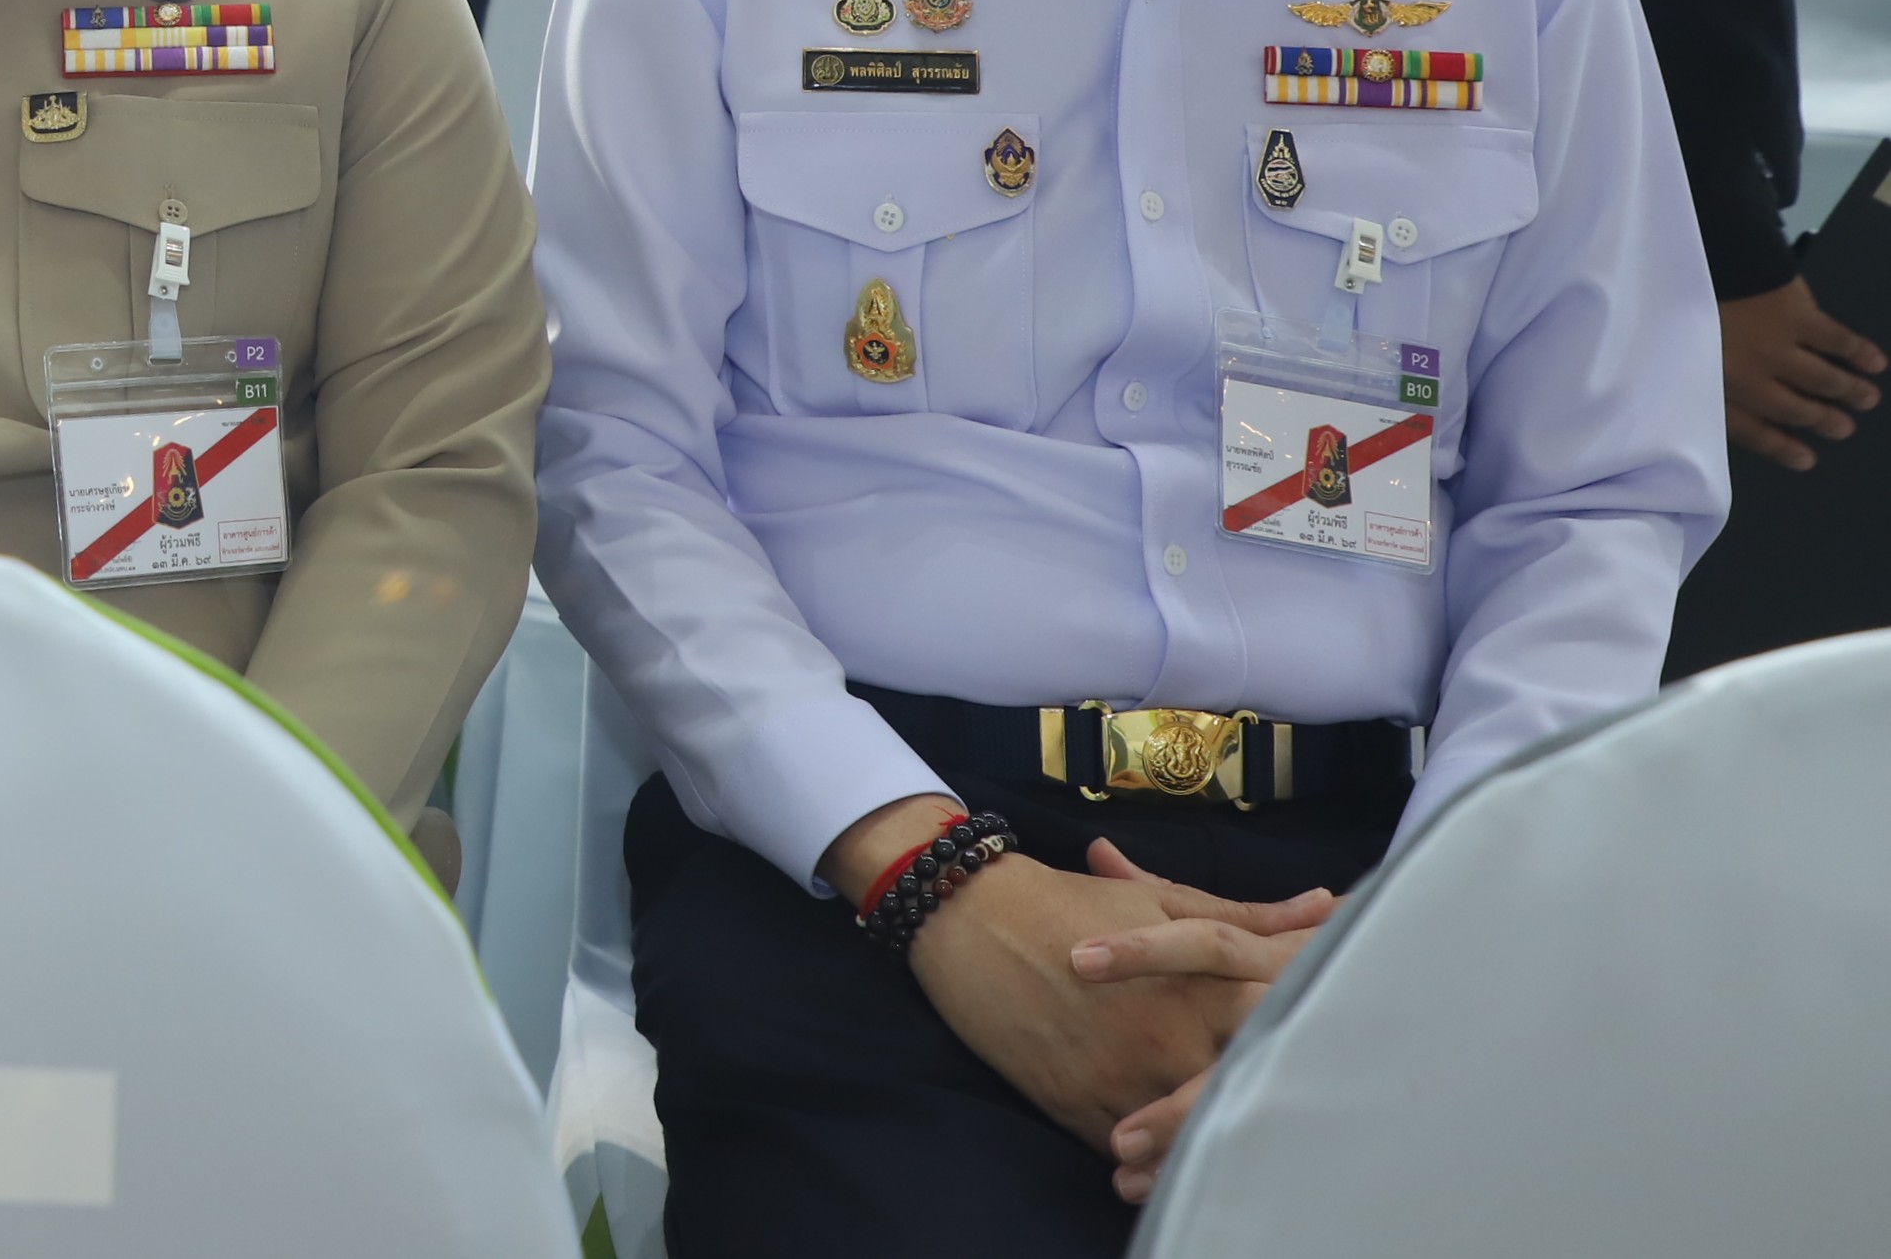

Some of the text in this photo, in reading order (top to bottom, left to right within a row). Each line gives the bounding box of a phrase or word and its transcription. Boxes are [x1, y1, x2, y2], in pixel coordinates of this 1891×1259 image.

[850, 60, 970, 83] พลพิศิลป์ สุวรรณชัย
[246, 346, 265, 361] P2
[1411, 352, 1429, 368] P2
[244, 384, 267, 399] B11
[1406, 382, 1432, 399] B10
[1307, 508, 1349, 530] ผู้ร่วมพิธี
[159, 532, 202, 552] ผู้ร่วมพิธี
[170, 553, 192, 567] มี.ค.
